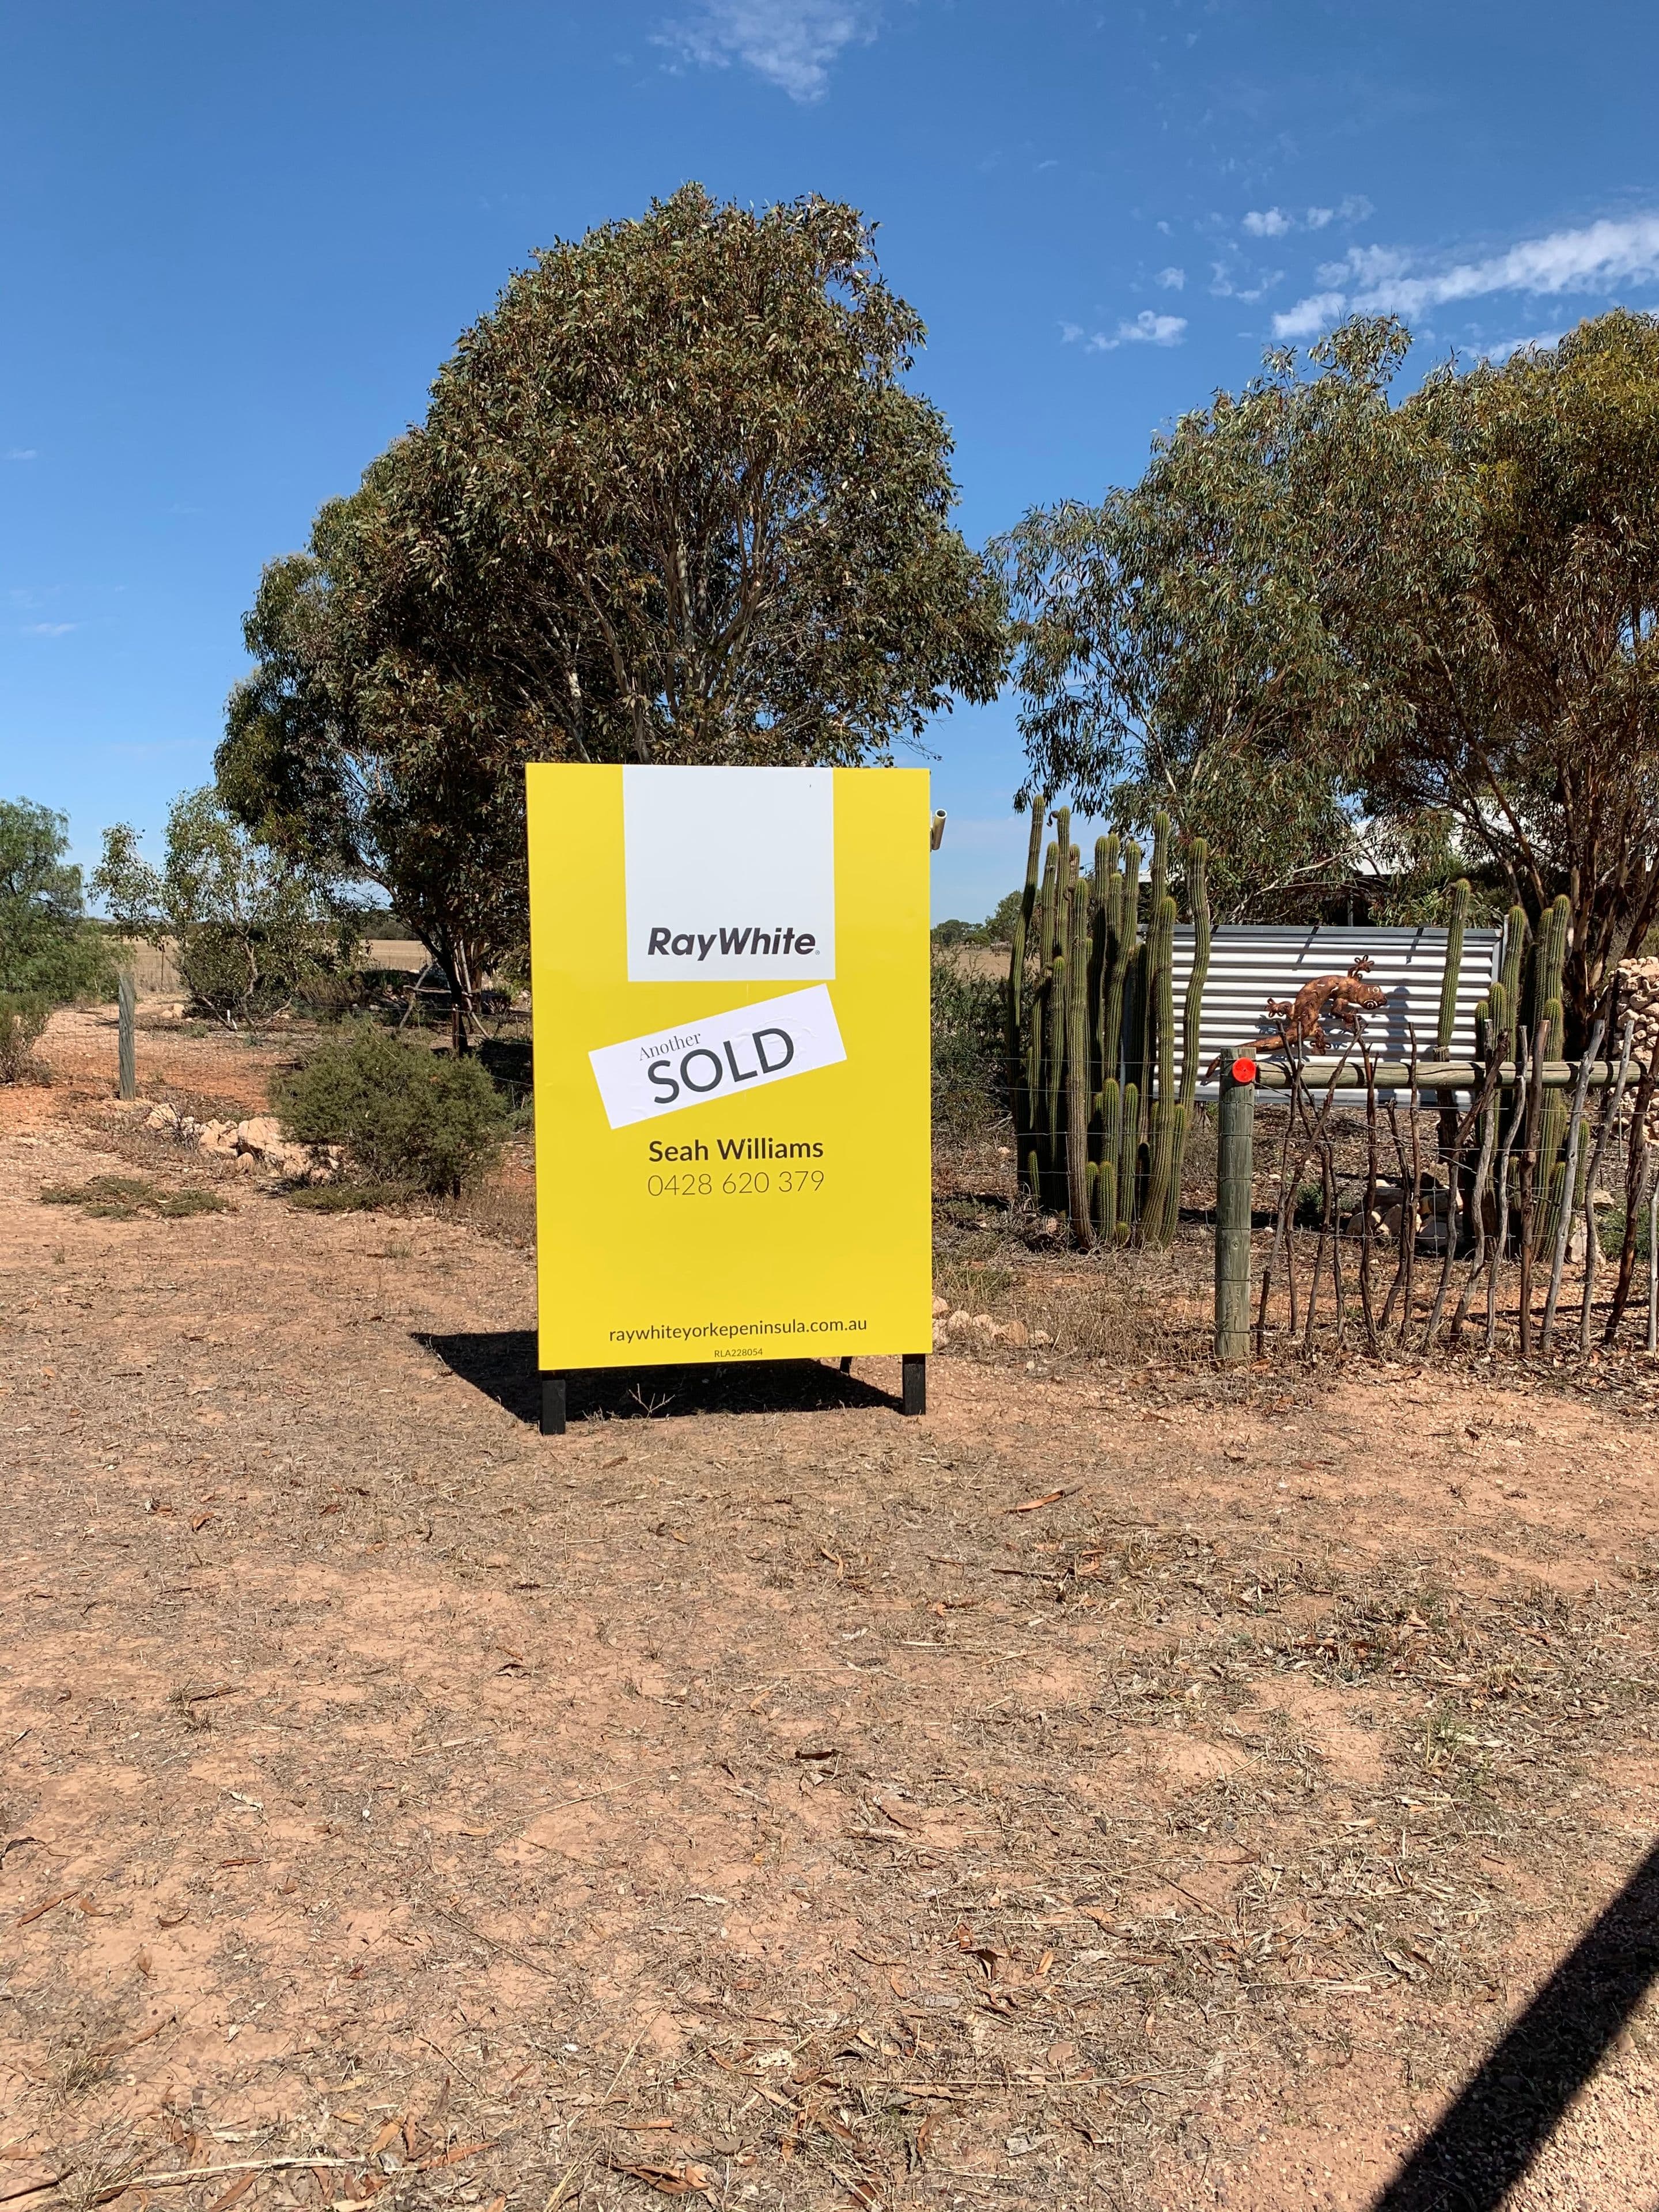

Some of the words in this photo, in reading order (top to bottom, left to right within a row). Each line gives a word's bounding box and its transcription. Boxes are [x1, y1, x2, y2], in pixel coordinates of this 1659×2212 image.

[639, 1031, 702, 1061] Another
[647, 1028, 795, 1105] SOLD
[649, 1139, 709, 1162] Seah
[716, 1137, 824, 1160] Williams
[647, 1173, 713, 1196] 0428
[722, 1172, 770, 1194] 620
[778, 1170, 824, 1192] 379
[609, 1319, 868, 1344] raywhiteyorkepeninsula.com.au
[714, 1348, 763, 1358] RLA228054
